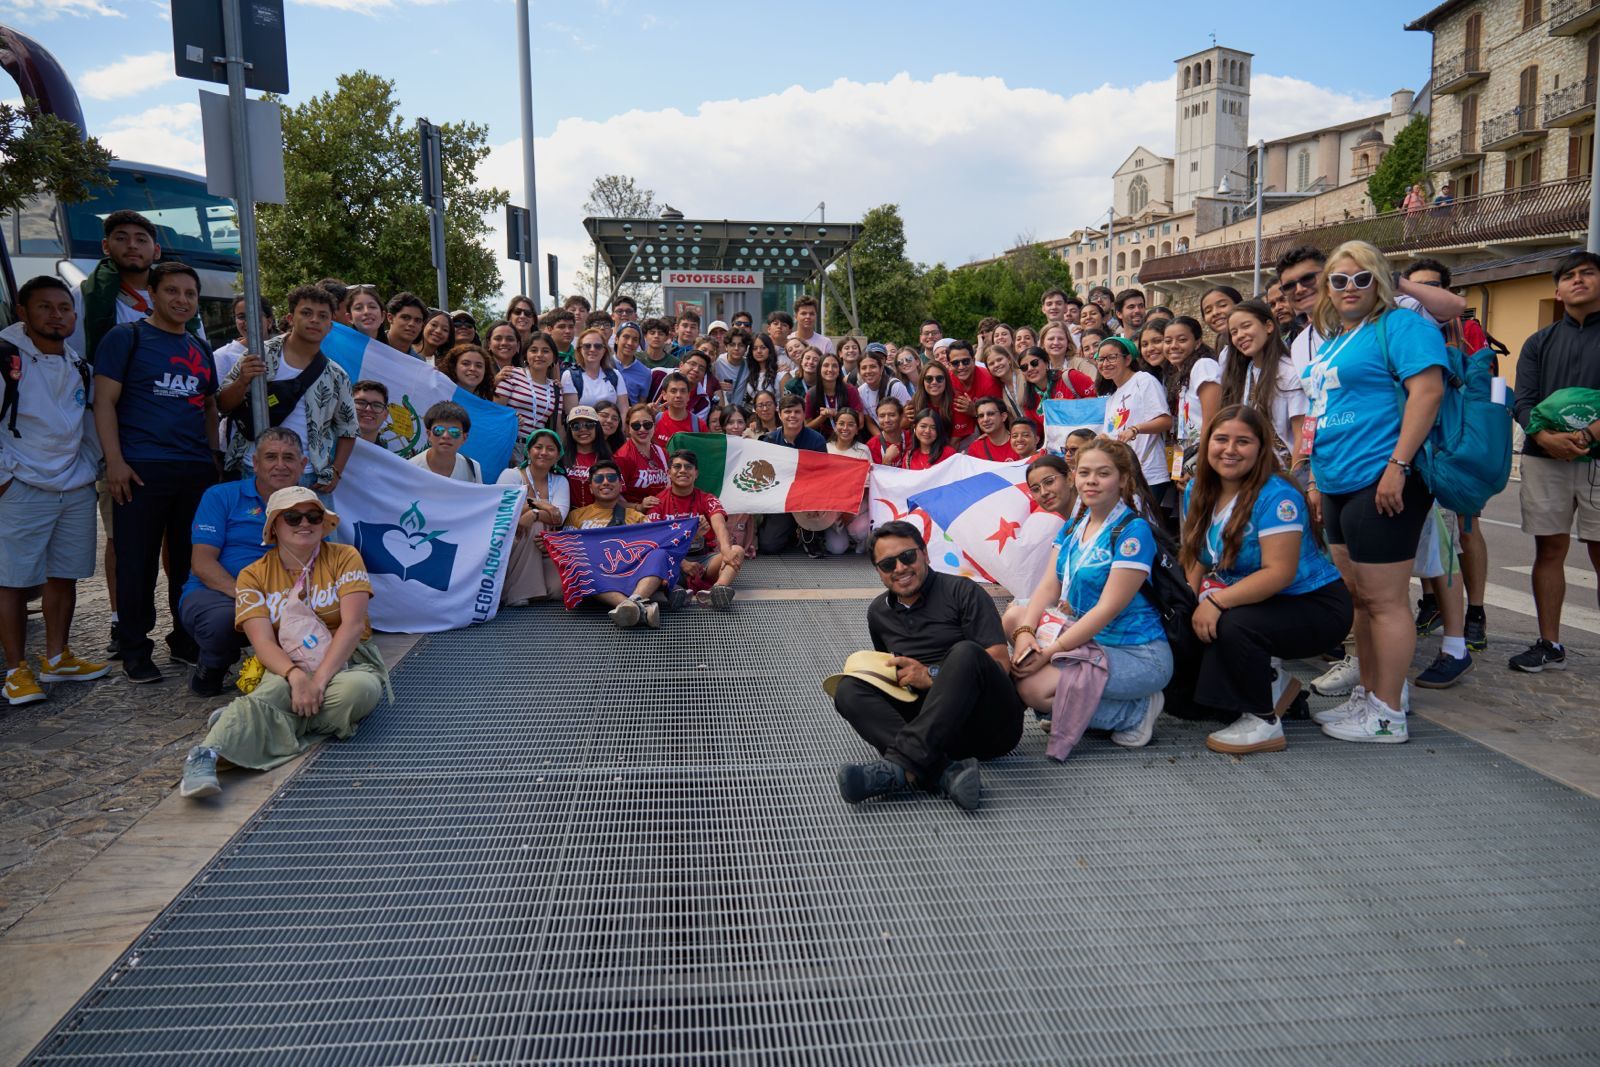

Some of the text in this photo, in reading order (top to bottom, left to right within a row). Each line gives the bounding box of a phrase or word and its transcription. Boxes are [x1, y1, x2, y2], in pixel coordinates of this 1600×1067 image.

[670, 273, 755, 284] FOTOTESSERA
[154, 372, 199, 392] JAR
[472, 578, 495, 623] LEGIO
